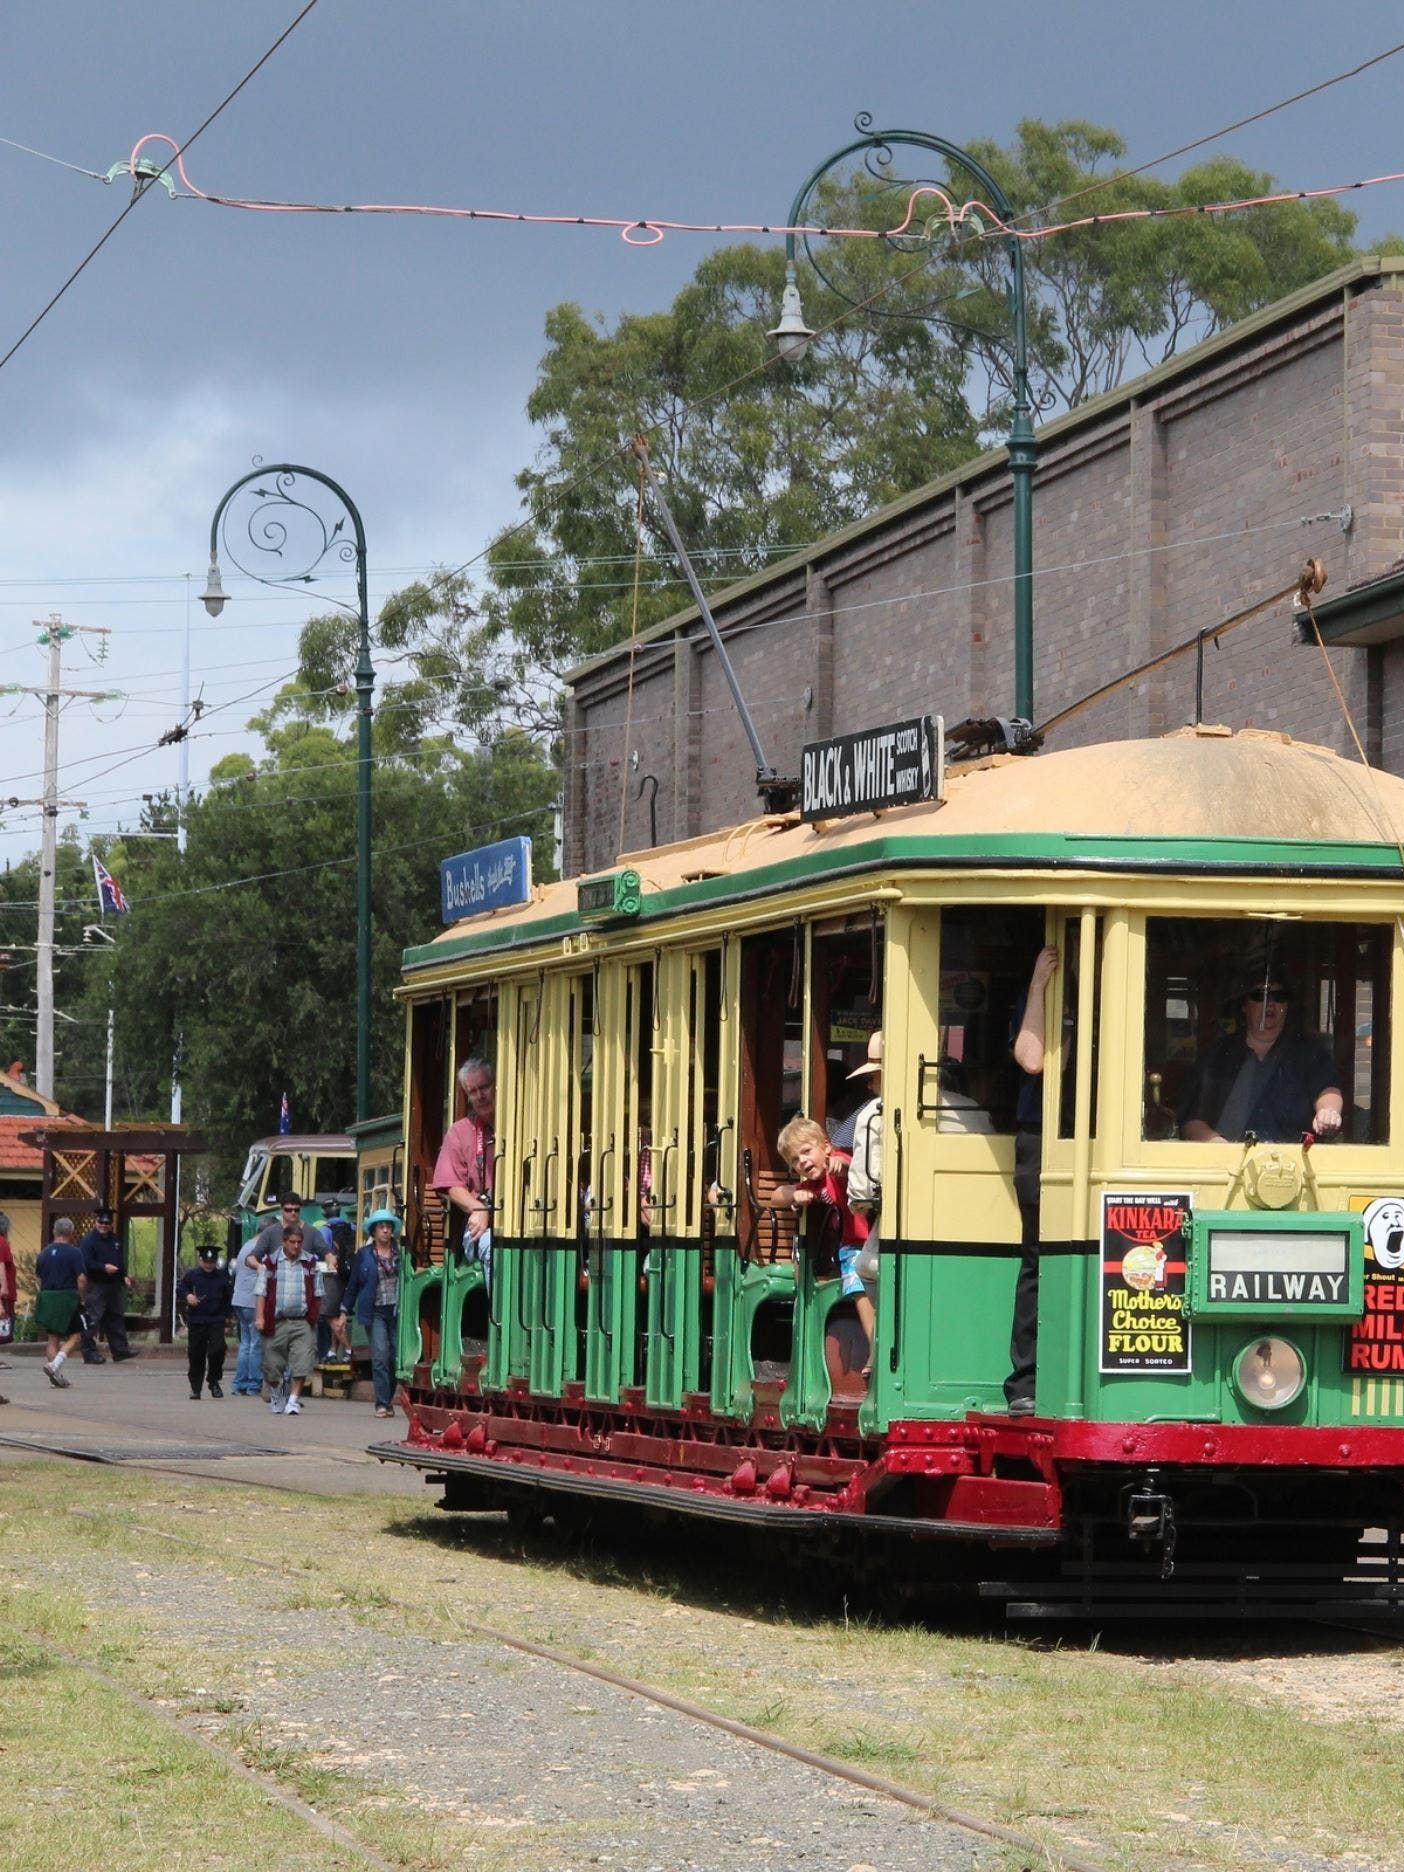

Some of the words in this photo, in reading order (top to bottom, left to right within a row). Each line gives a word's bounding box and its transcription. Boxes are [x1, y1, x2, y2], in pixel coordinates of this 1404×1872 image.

[896, 728, 918, 755] SCOTCH
[803, 746, 842, 812] BLACK
[844, 765, 851, 805] &
[854, 733, 896, 802] WHITE
[896, 766, 918, 793] WHISKY
[446, 862, 485, 910] Bushells
[1107, 1207, 1184, 1229] KINKARA
[1135, 1230, 1158, 1239] TEA
[1210, 1274, 1344, 1300] RAILWAY
[1371, 1273, 1395, 1281] Shout
[1112, 1310, 1180, 1332] Choice
[1108, 1334, 1184, 1353] FLOUR
